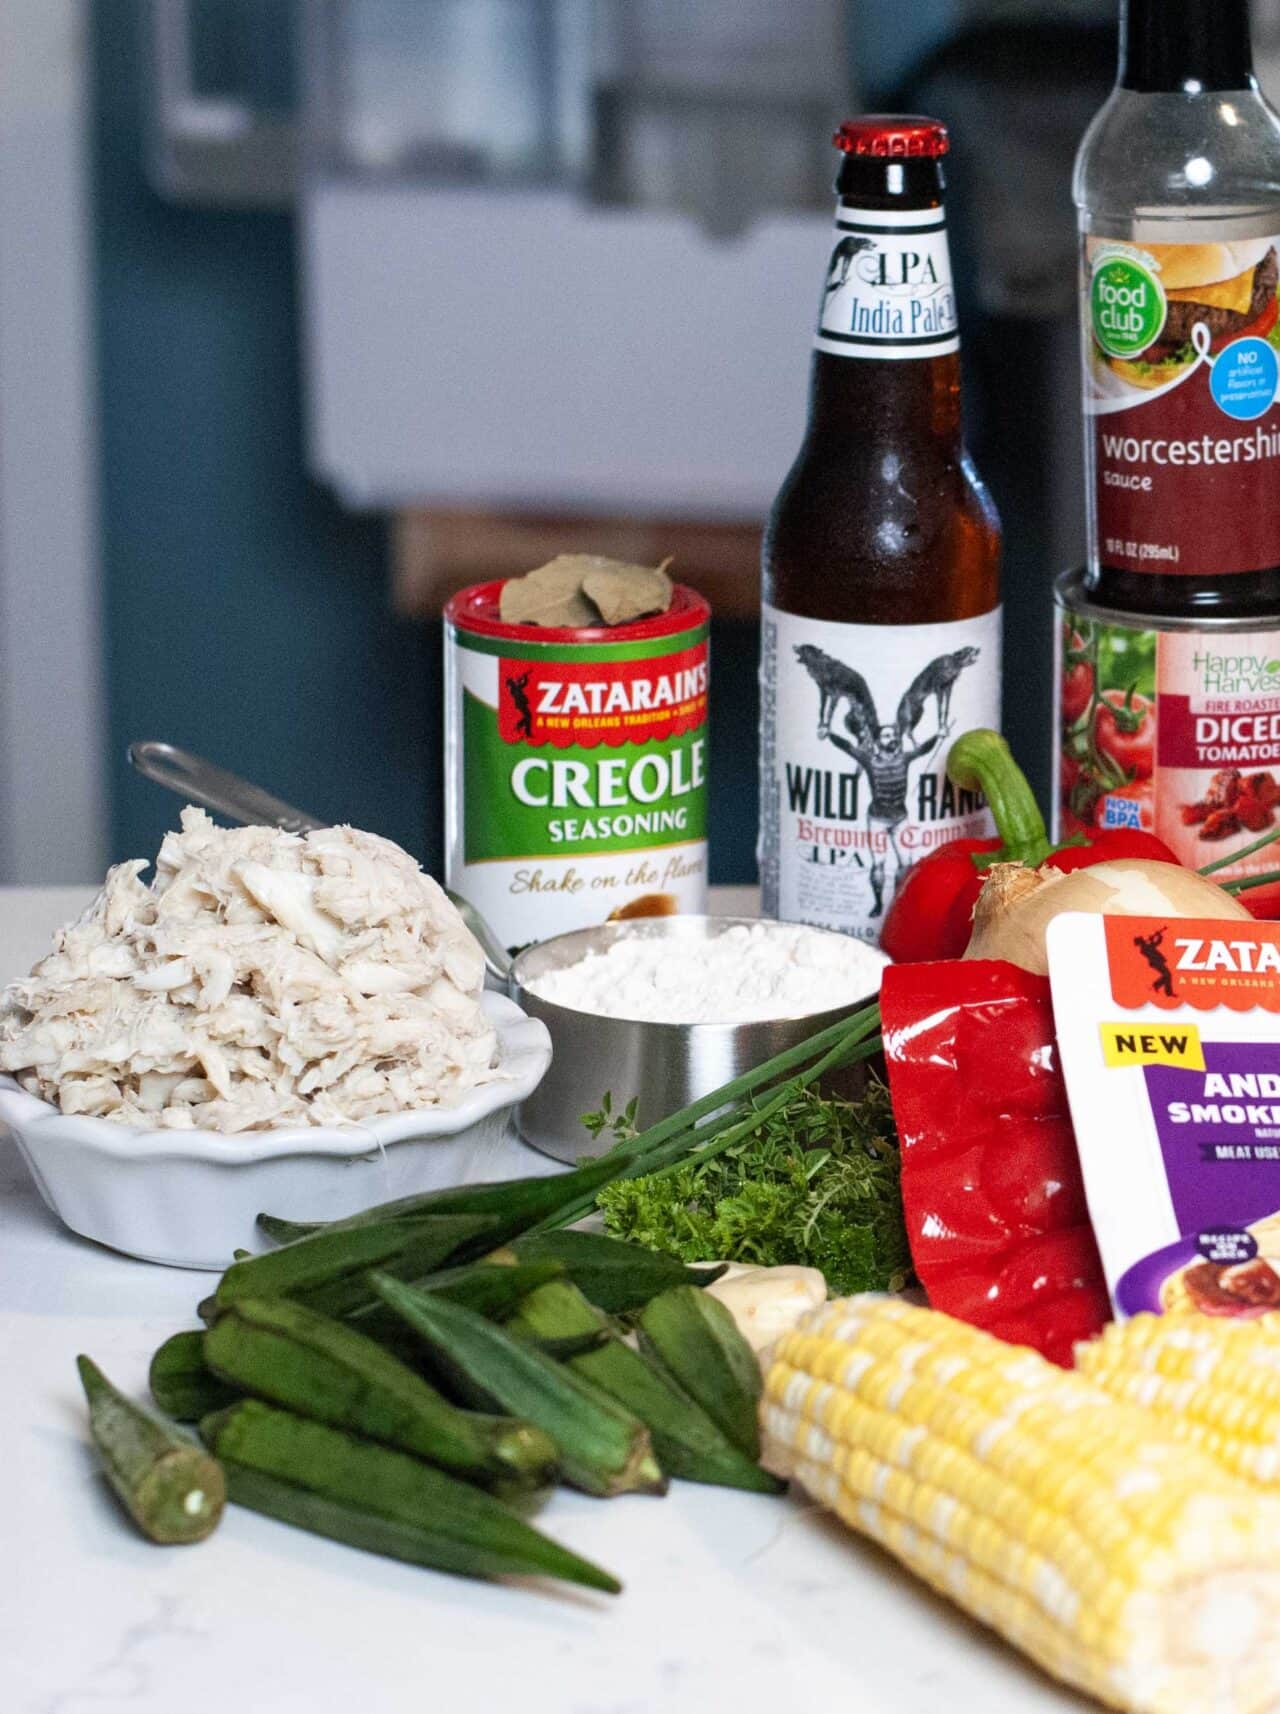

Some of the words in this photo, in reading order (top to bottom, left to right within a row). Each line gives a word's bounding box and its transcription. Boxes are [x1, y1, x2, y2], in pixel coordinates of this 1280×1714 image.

[877, 251, 938, 286] IPA
[1098, 276, 1146, 307] food
[850, 297, 904, 334] India
[1101, 304, 1145, 332] club
[1237, 351, 1258, 364] NO
[1103, 470, 1153, 491] sauce
[1192, 651, 1268, 676] Happy
[1206, 699, 1230, 712] FIRE
[537, 717, 544, 727] A
[546, 717, 570, 728] NEW
[573, 716, 621, 729] ORLEANS
[511, 738, 706, 808] CREOLE
[785, 762, 859, 821] WILD
[1106, 798, 1139, 811] NON
[548, 806, 688, 843] SEASONING
[1106, 810, 1140, 829] BPA
[797, 818, 889, 854] Brewing
[805, 845, 865, 868] IPA
[510, 867, 585, 894] Shake
[591, 875, 621, 889] on
[624, 861, 658, 886] the
[1179, 977, 1187, 985] A
[1192, 977, 1213, 986] NEW
[1221, 978, 1275, 989] ORLEANS
[1115, 1034, 1188, 1054] NEW
[1215, 1145, 1252, 1159] MEAT
